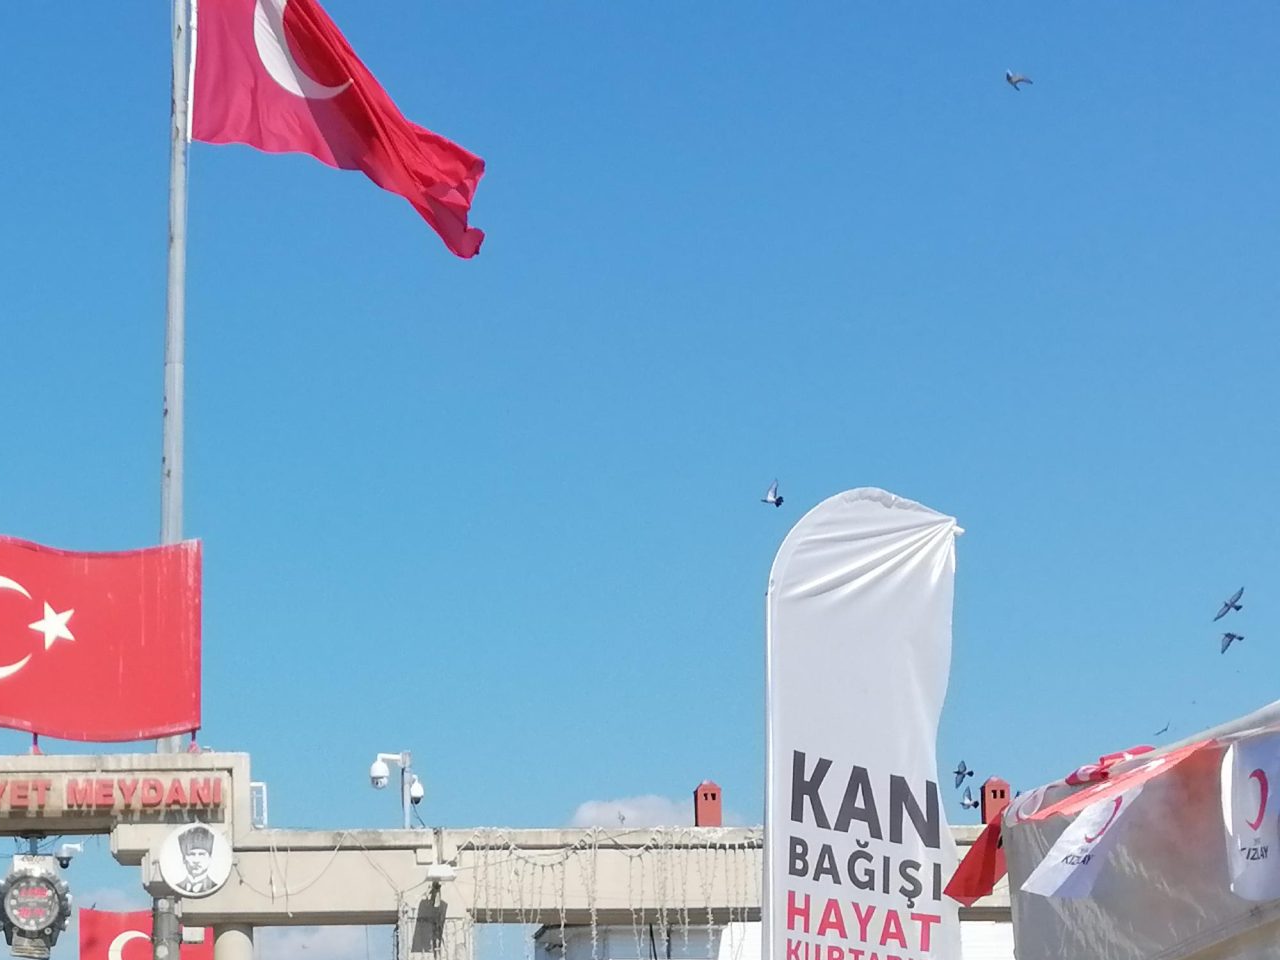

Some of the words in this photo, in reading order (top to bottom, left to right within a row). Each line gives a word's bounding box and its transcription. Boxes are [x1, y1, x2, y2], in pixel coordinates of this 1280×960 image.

[66, 776, 223, 810] MEYDANI
[790, 749, 941, 849] KAN
[787, 835, 942, 909] BAĞIŞI
[786, 889, 942, 953] HAYAT
